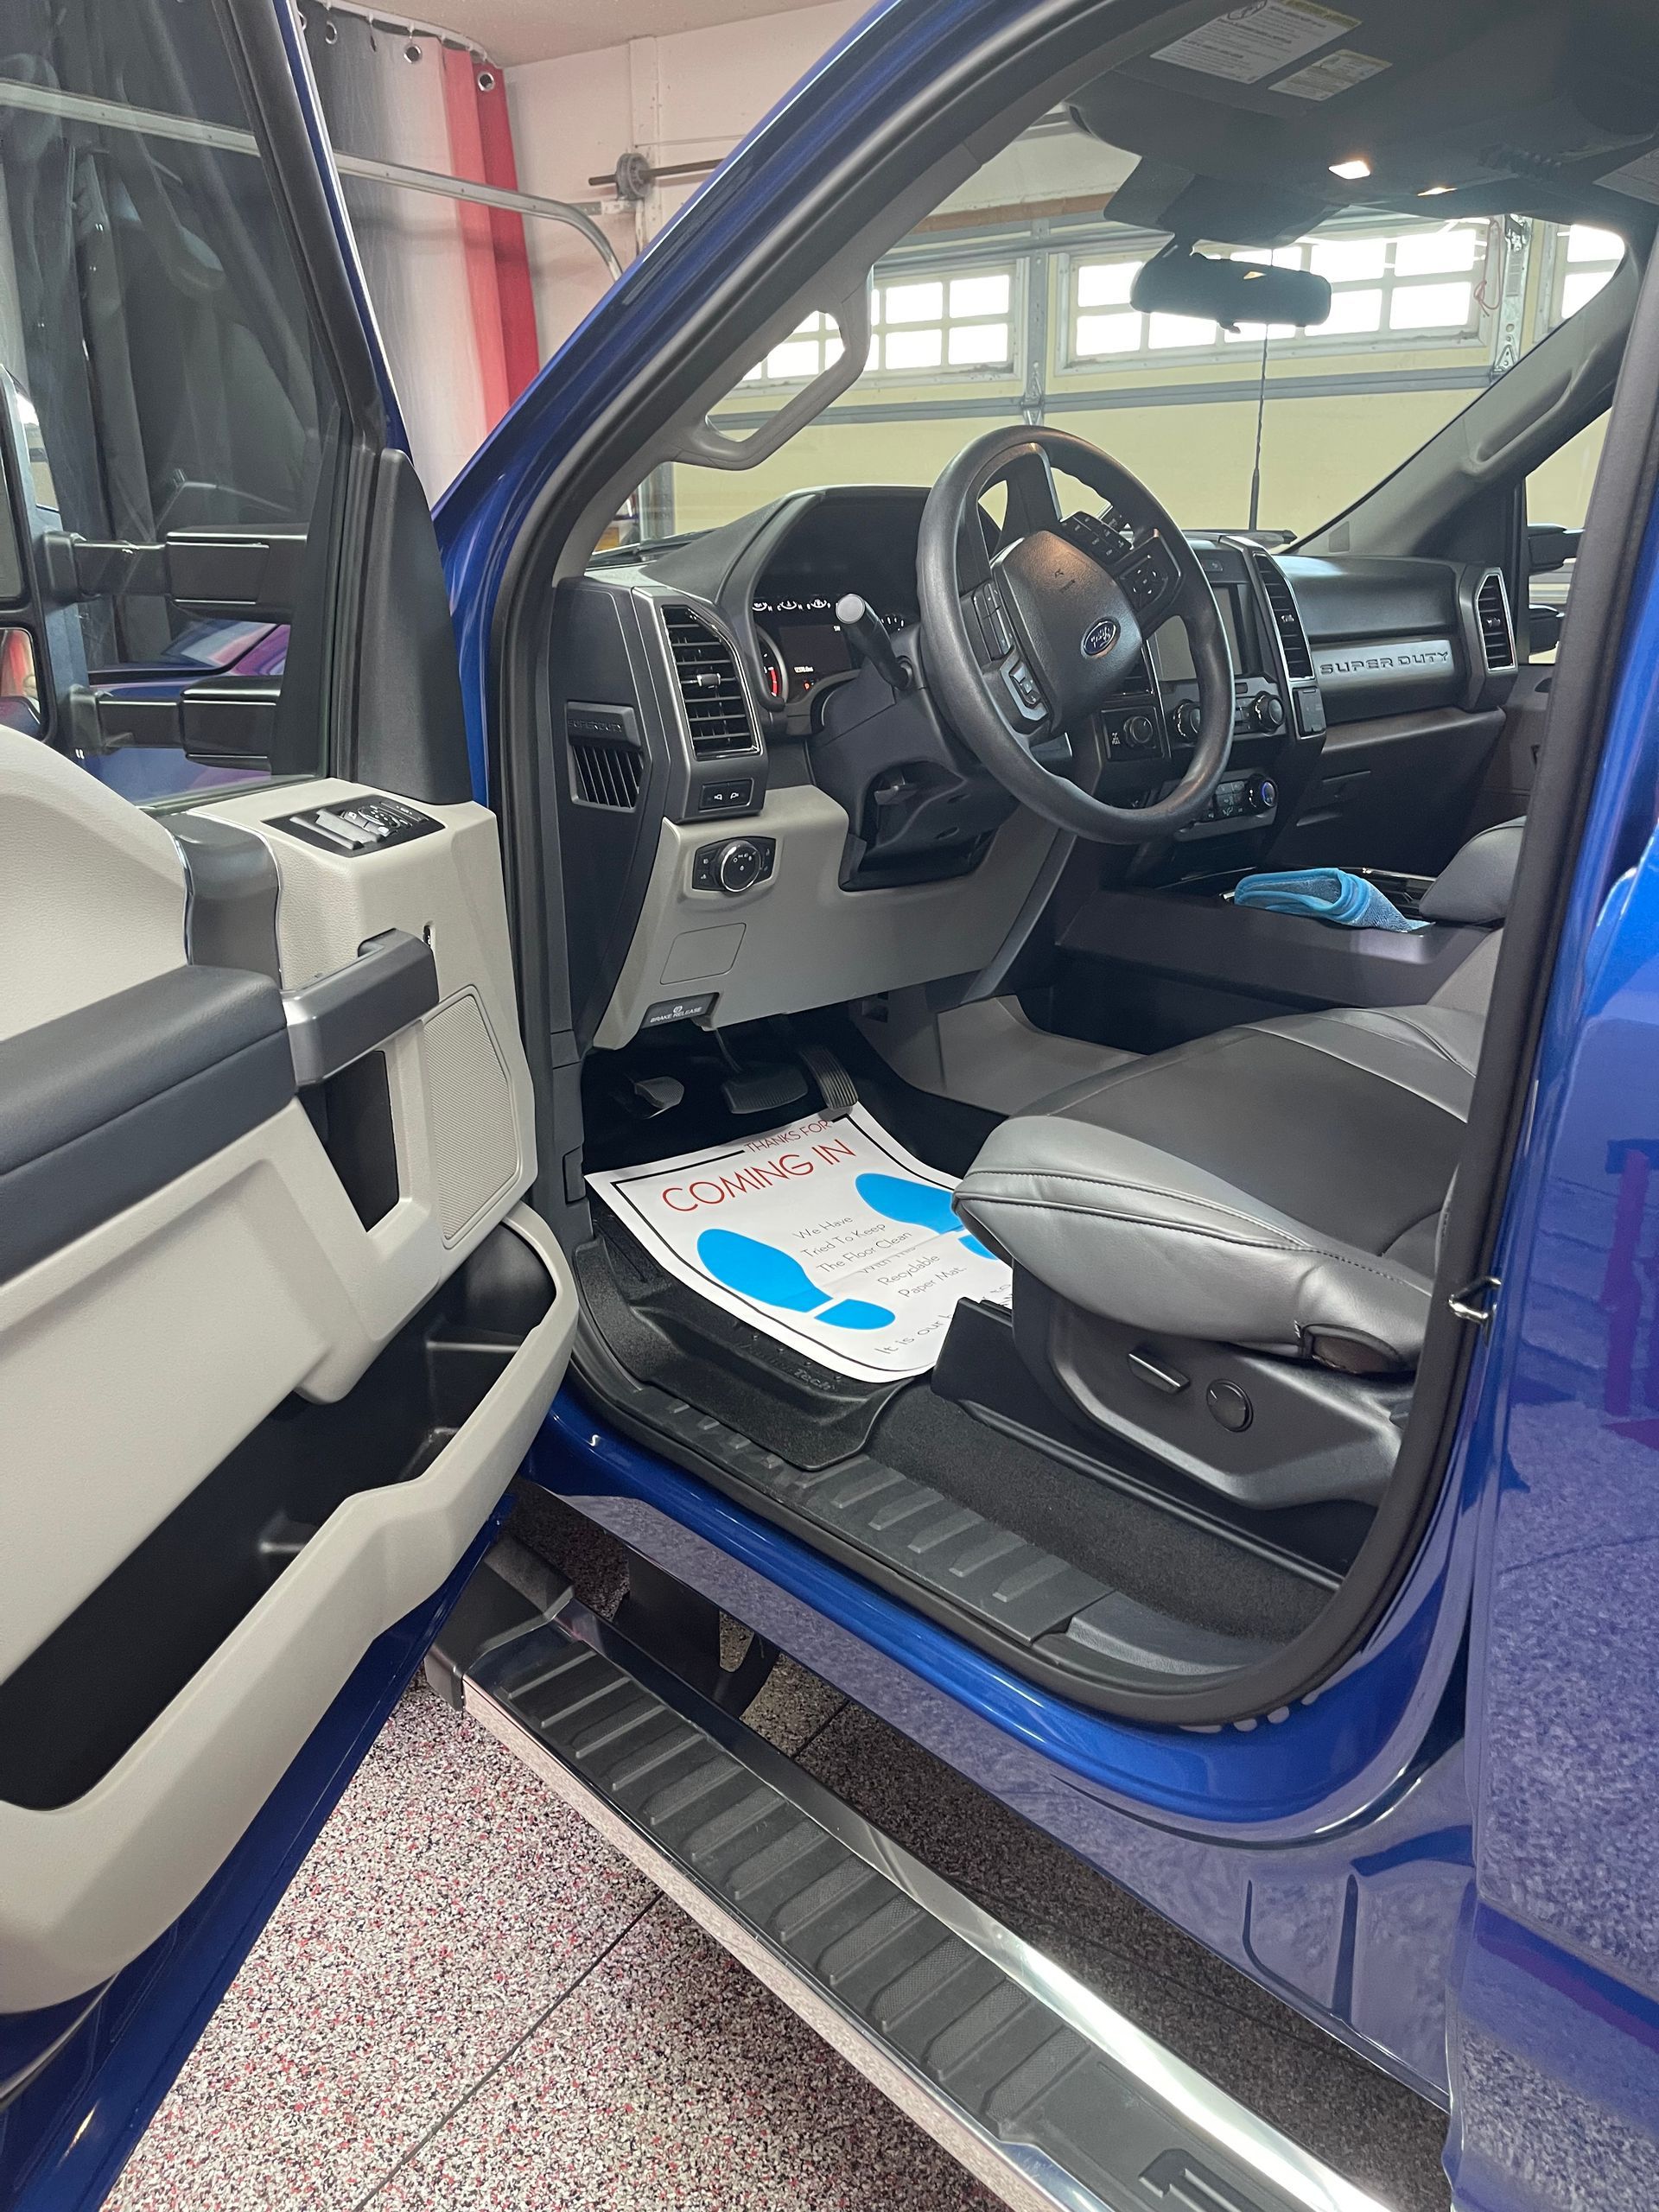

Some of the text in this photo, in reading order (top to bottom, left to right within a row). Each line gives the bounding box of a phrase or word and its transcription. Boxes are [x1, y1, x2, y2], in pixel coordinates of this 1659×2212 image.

[1319, 651, 1448, 676] SUPER DUTY
[650, 1006, 703, 1023] BRAKE RELEASE
[743, 1119, 832, 1153] THANKS FOR
[661, 1138, 857, 1212] COMING IN
[792, 1216, 854, 1239] We Have
[800, 1223, 887, 1258] Tried To Keep
[816, 1231, 912, 1273] The Floor Clean
[898, 1265, 969, 1299] Paper Mat.
[874, 1345, 899, 1355] It
[894, 1337, 915, 1345] is
[917, 1320, 945, 1336] our
